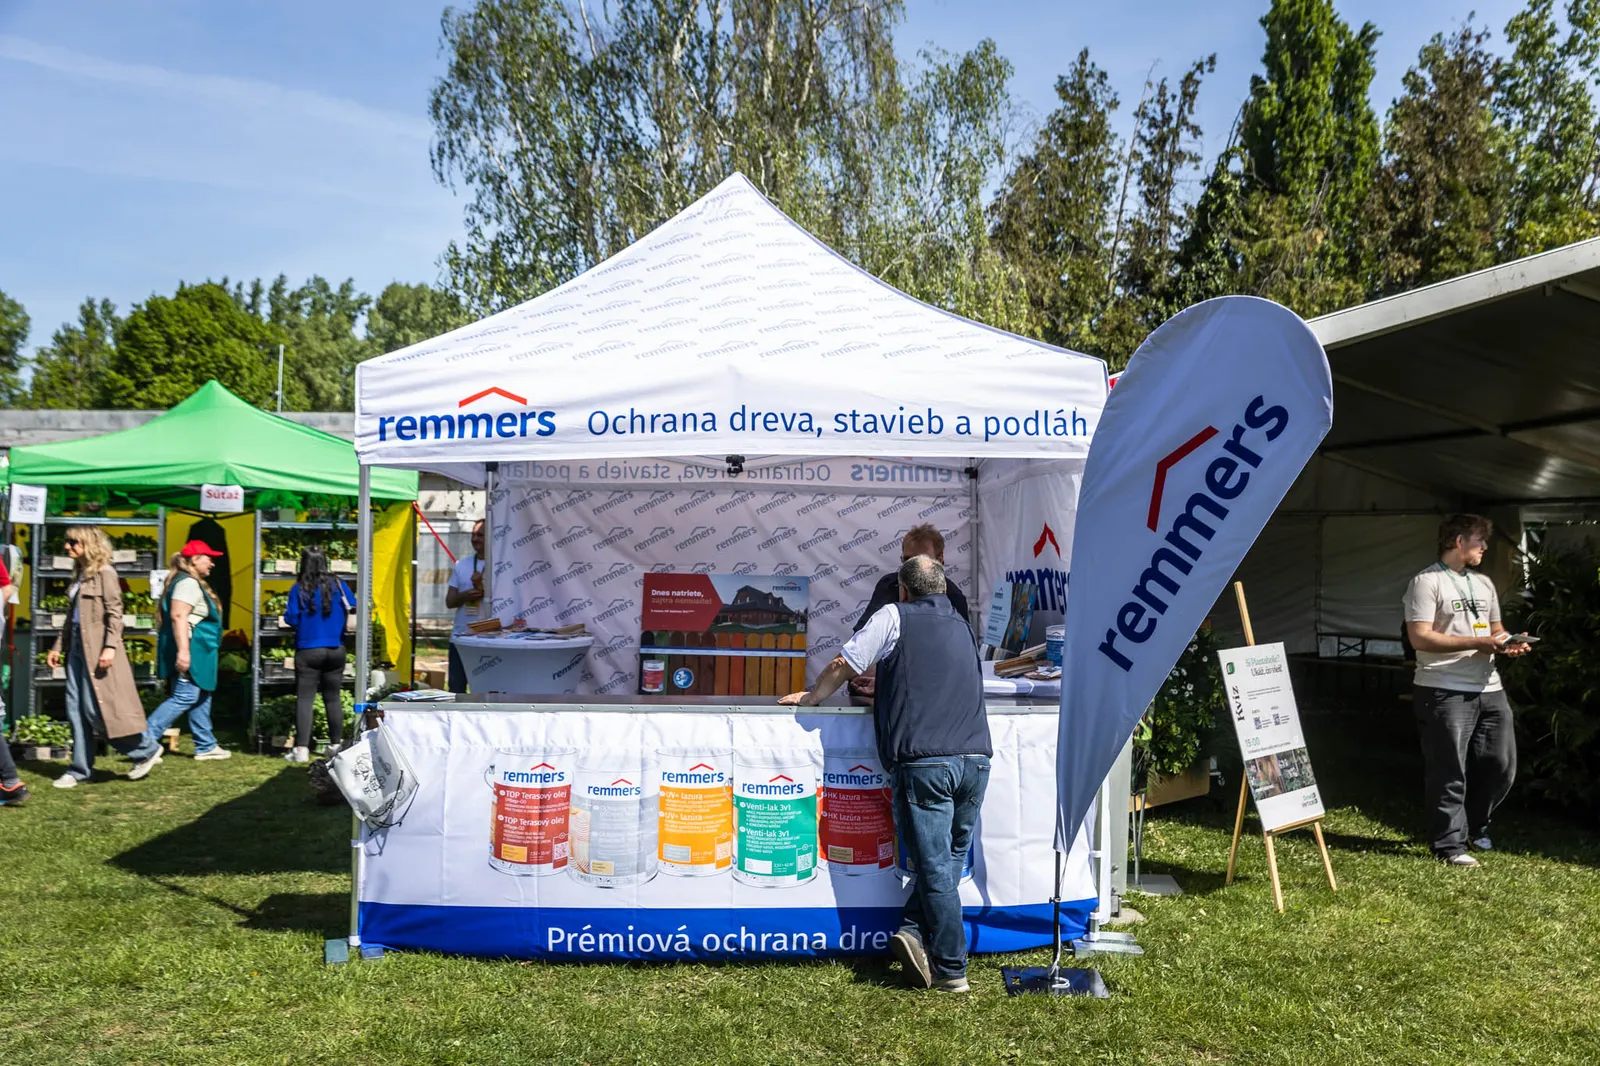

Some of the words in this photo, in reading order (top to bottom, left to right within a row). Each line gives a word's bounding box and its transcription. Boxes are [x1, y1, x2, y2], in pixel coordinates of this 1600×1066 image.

[379, 411, 556, 441] remmers
[587, 408, 718, 437] Ochrana
[729, 405, 823, 438] dreva,
[833, 406, 944, 435] stavieb
[955, 414, 971, 436] a
[984, 409, 1087, 441] podláh
[511, 489, 551, 513] remmers
[551, 489, 593, 515] remmers
[592, 490, 634, 516] remmers
[633, 490, 675, 516] remmers
[674, 490, 716, 516] remmers
[715, 490, 756, 515] remmers
[756, 491, 797, 516] remmers
[796, 494, 837, 517] remmers
[836, 495, 877, 518] remmers
[877, 496, 918, 519] remmers
[917, 495, 958, 520] remmers
[512, 526, 552, 550] remmers
[551, 526, 593, 551] remmers
[592, 526, 634, 552] remmers
[633, 525, 675, 552] remmers
[674, 526, 717, 552] remmers
[715, 526, 757, 552] remmers
[757, 527, 798, 552] remmers
[797, 528, 838, 552] remmers
[838, 529, 879, 554] remmers
[1098, 395, 1289, 671] remmers
[512, 559, 552, 586] remmers
[552, 561, 593, 588] remmers
[592, 562, 635, 588] remmers
[503, 771, 565, 783] remmers
[662, 771, 724, 784] remmers
[742, 783, 804, 795] remmers
[823, 772, 883, 785] remmers
[506, 790, 520, 798] TOP
[521, 791, 552, 801] Terasový
[588, 785, 641, 796] remmers
[746, 802, 778, 811] Venti-lak
[504, 816, 518, 824] TOP
[519, 817, 550, 827] Terasový
[746, 828, 776, 837] Venti-lak
[547, 925, 691, 953] Prémiová
[702, 926, 827, 952] ochrana
[839, 925, 895, 951] dre
